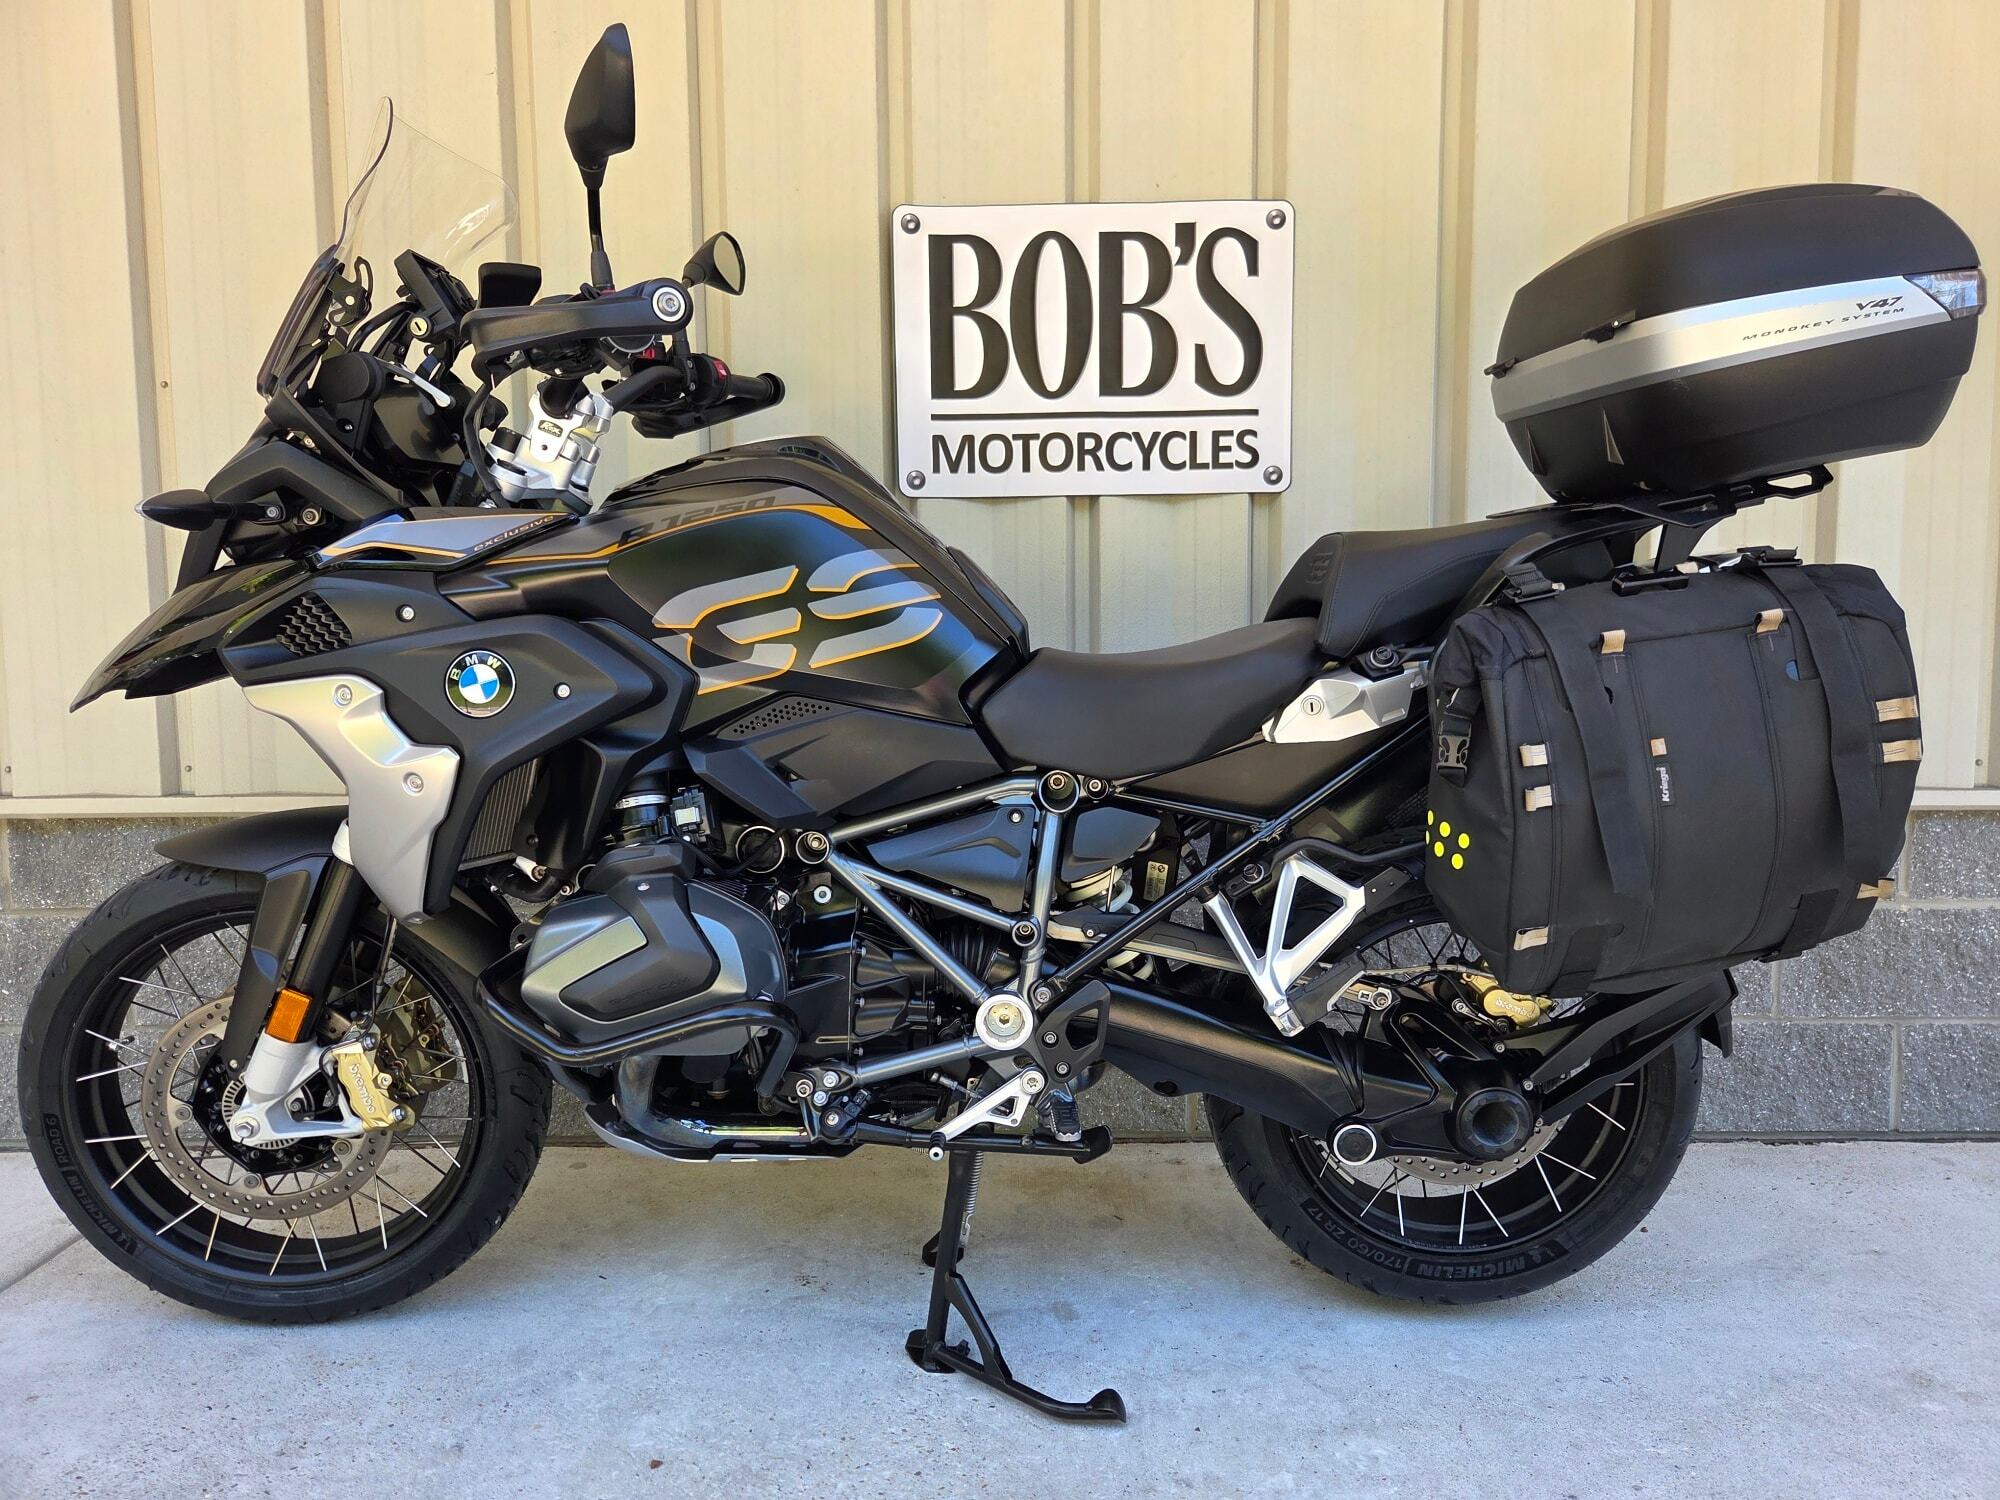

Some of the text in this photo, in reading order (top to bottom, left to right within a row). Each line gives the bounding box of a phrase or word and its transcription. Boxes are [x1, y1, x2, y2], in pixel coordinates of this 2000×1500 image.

[928, 221, 1264, 401] BOB'S
[1856, 295, 1904, 312] V47
[1742, 307, 1905, 342] MONOKEY SYSTEM
[931, 428, 1261, 475] MOTORCYCLES
[660, 495, 776, 528] 1250
[473, 515, 554, 552] exclusive
[449, 653, 502, 681] BMW
[349, 1062, 376, 1114] brembo
[50, 1128, 71, 1166] ROAD
[66, 1173, 120, 1236] MICHELIN
[1306, 1207, 1325, 1221] 17
[1323, 1220, 1347, 1240] ZR
[1346, 1237, 1402, 1269] 170/60
[1417, 1256, 1526, 1279] MICHELIN
